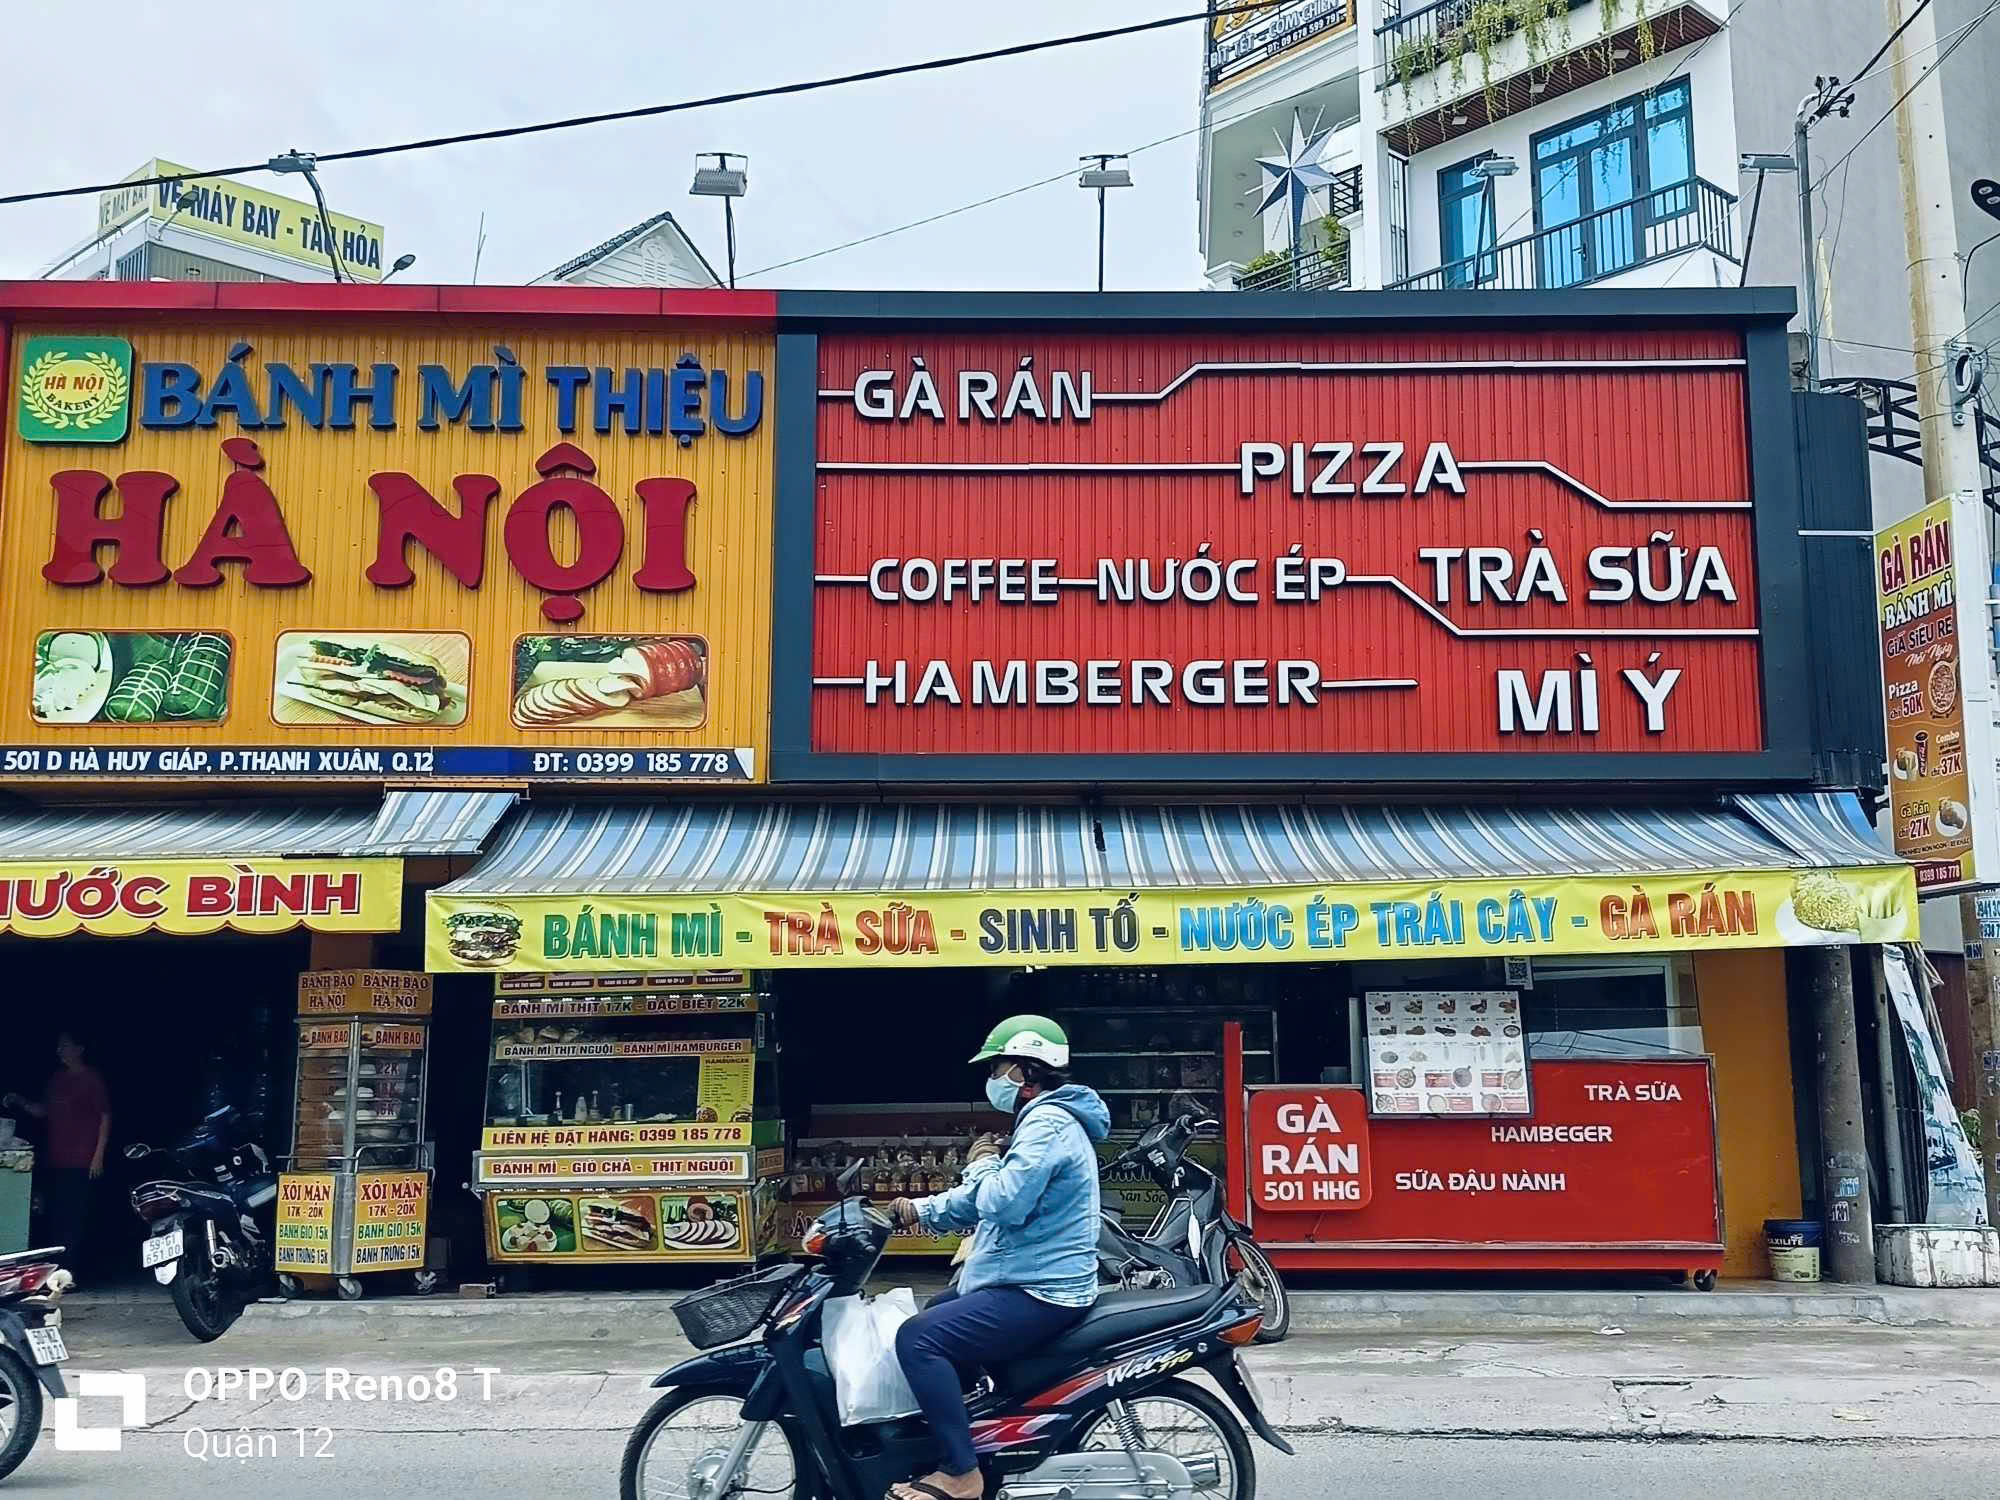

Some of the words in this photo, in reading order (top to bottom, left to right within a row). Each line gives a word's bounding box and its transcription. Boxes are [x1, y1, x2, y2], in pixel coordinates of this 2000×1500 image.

[190, 184, 237, 227] MÁY
[242, 199, 280, 240] BAY
[343, 224, 380, 269] HỎA
[44, 372, 67, 390] HÀ
[73, 373, 104, 392] NỘI
[854, 356, 945, 419] GÀ
[958, 356, 1092, 419] RÁN
[46, 393, 100, 411] BAKERY
[139, 342, 400, 431] BÁNH
[417, 343, 526, 432] MÌ
[545, 353, 763, 448] THIỆU
[1240, 442, 1466, 495] PIZZA
[41, 438, 313, 588] HÀ
[365, 442, 697, 623] NỘI
[1419, 528, 1568, 602] TRÀ
[1588, 530, 1738, 602] SỮA
[1881, 535, 1907, 593] GÀ
[1910, 517, 1950, 580] RÁN
[868, 558, 1058, 602] COFFEE
[1097, 543, 1258, 602] NƯỚC
[1275, 543, 1346, 601] ÉP
[1884, 590, 1930, 631] BÁNH
[1932, 571, 1953, 610] MÌ
[865, 660, 1320, 704] HAMBERGER
[1497, 652, 1600, 733] MÌ
[1623, 652, 1682, 732] Ý
[1889, 680, 1918, 699] Pizza
[1903, 694, 1923, 716] 50K
[1936, 731, 1960, 743] Combo
[4, 751, 40, 771] 501
[47, 751, 61, 770] D
[70, 748, 99, 771] HÀ
[108, 751, 151, 771] HUY
[159, 747, 212, 773] GIÁP,
[220, 751, 306, 775] P.THẠNH
[318, 748, 384, 773] XUÂN,
[392, 752, 433, 773] Q.12
[533, 753, 568, 773] ĐT:
[576, 753, 634, 773] 0399
[647, 753, 681, 773] 185
[689, 753, 728, 773] 778
[1941, 755, 1961, 775] 37K
[1910, 817, 1930, 838] 27K
[186, 864, 361, 917] BÌNH
[543, 904, 658, 958] BÁNH
[671, 903, 723, 957] MÌ
[764, 901, 844, 957] TRÀ
[854, 901, 938, 957] SỮA
[979, 908, 1077, 954] SINH
[1091, 893, 1140, 951] TỐ
[1180, 896, 1294, 951] NƯỚC
[1306, 893, 1359, 949] ÉP
[1370, 892, 1464, 945] TRÁI
[1477, 889, 1557, 943] CÂY
[1600, 885, 1661, 940] GÀ
[1667, 882, 1759, 938] RÁN
[606, 1001, 632, 1012] 17K
[719, 998, 745, 1008] 22K
[673, 1041, 742, 1053] HAMBURGER
[1584, 1081, 1630, 1101] TRÀ
[1635, 1081, 1682, 1101] SỮA
[1277, 1096, 1342, 1133] GÀ
[493, 1130, 525, 1144] LIÊN
[531, 1130, 549, 1147] HỆ
[555, 1130, 583, 1147] ĐẶT
[588, 1128, 634, 1143] HÀNG:
[639, 1128, 676, 1141] 0399
[682, 1128, 708, 1140] 185
[714, 1127, 741, 1140] 778
[1491, 1126, 1613, 1142] HAMBEGER
[493, 1161, 533, 1174] BÁNH
[538, 1160, 556, 1173] MÌ
[652, 1160, 682, 1174] THỊT
[688, 1159, 734, 1173] NGUỘI
[1262, 1137, 1359, 1175] RÁN
[282, 1181, 301, 1200] XÔI
[361, 1180, 387, 1200] XÔI
[1264, 1181, 1304, 1201] 501
[1313, 1180, 1360, 1200] HHG
[1395, 1168, 1444, 1190] SỮA
[1448, 1168, 1495, 1196] ĐẬU
[1502, 1169, 1566, 1191] NÀNH
[288, 1206, 300, 1217] 17K
[369, 1206, 387, 1216] 17K
[397, 1203, 416, 1215] 20K
[1106, 1349, 1177, 1387] Wave
